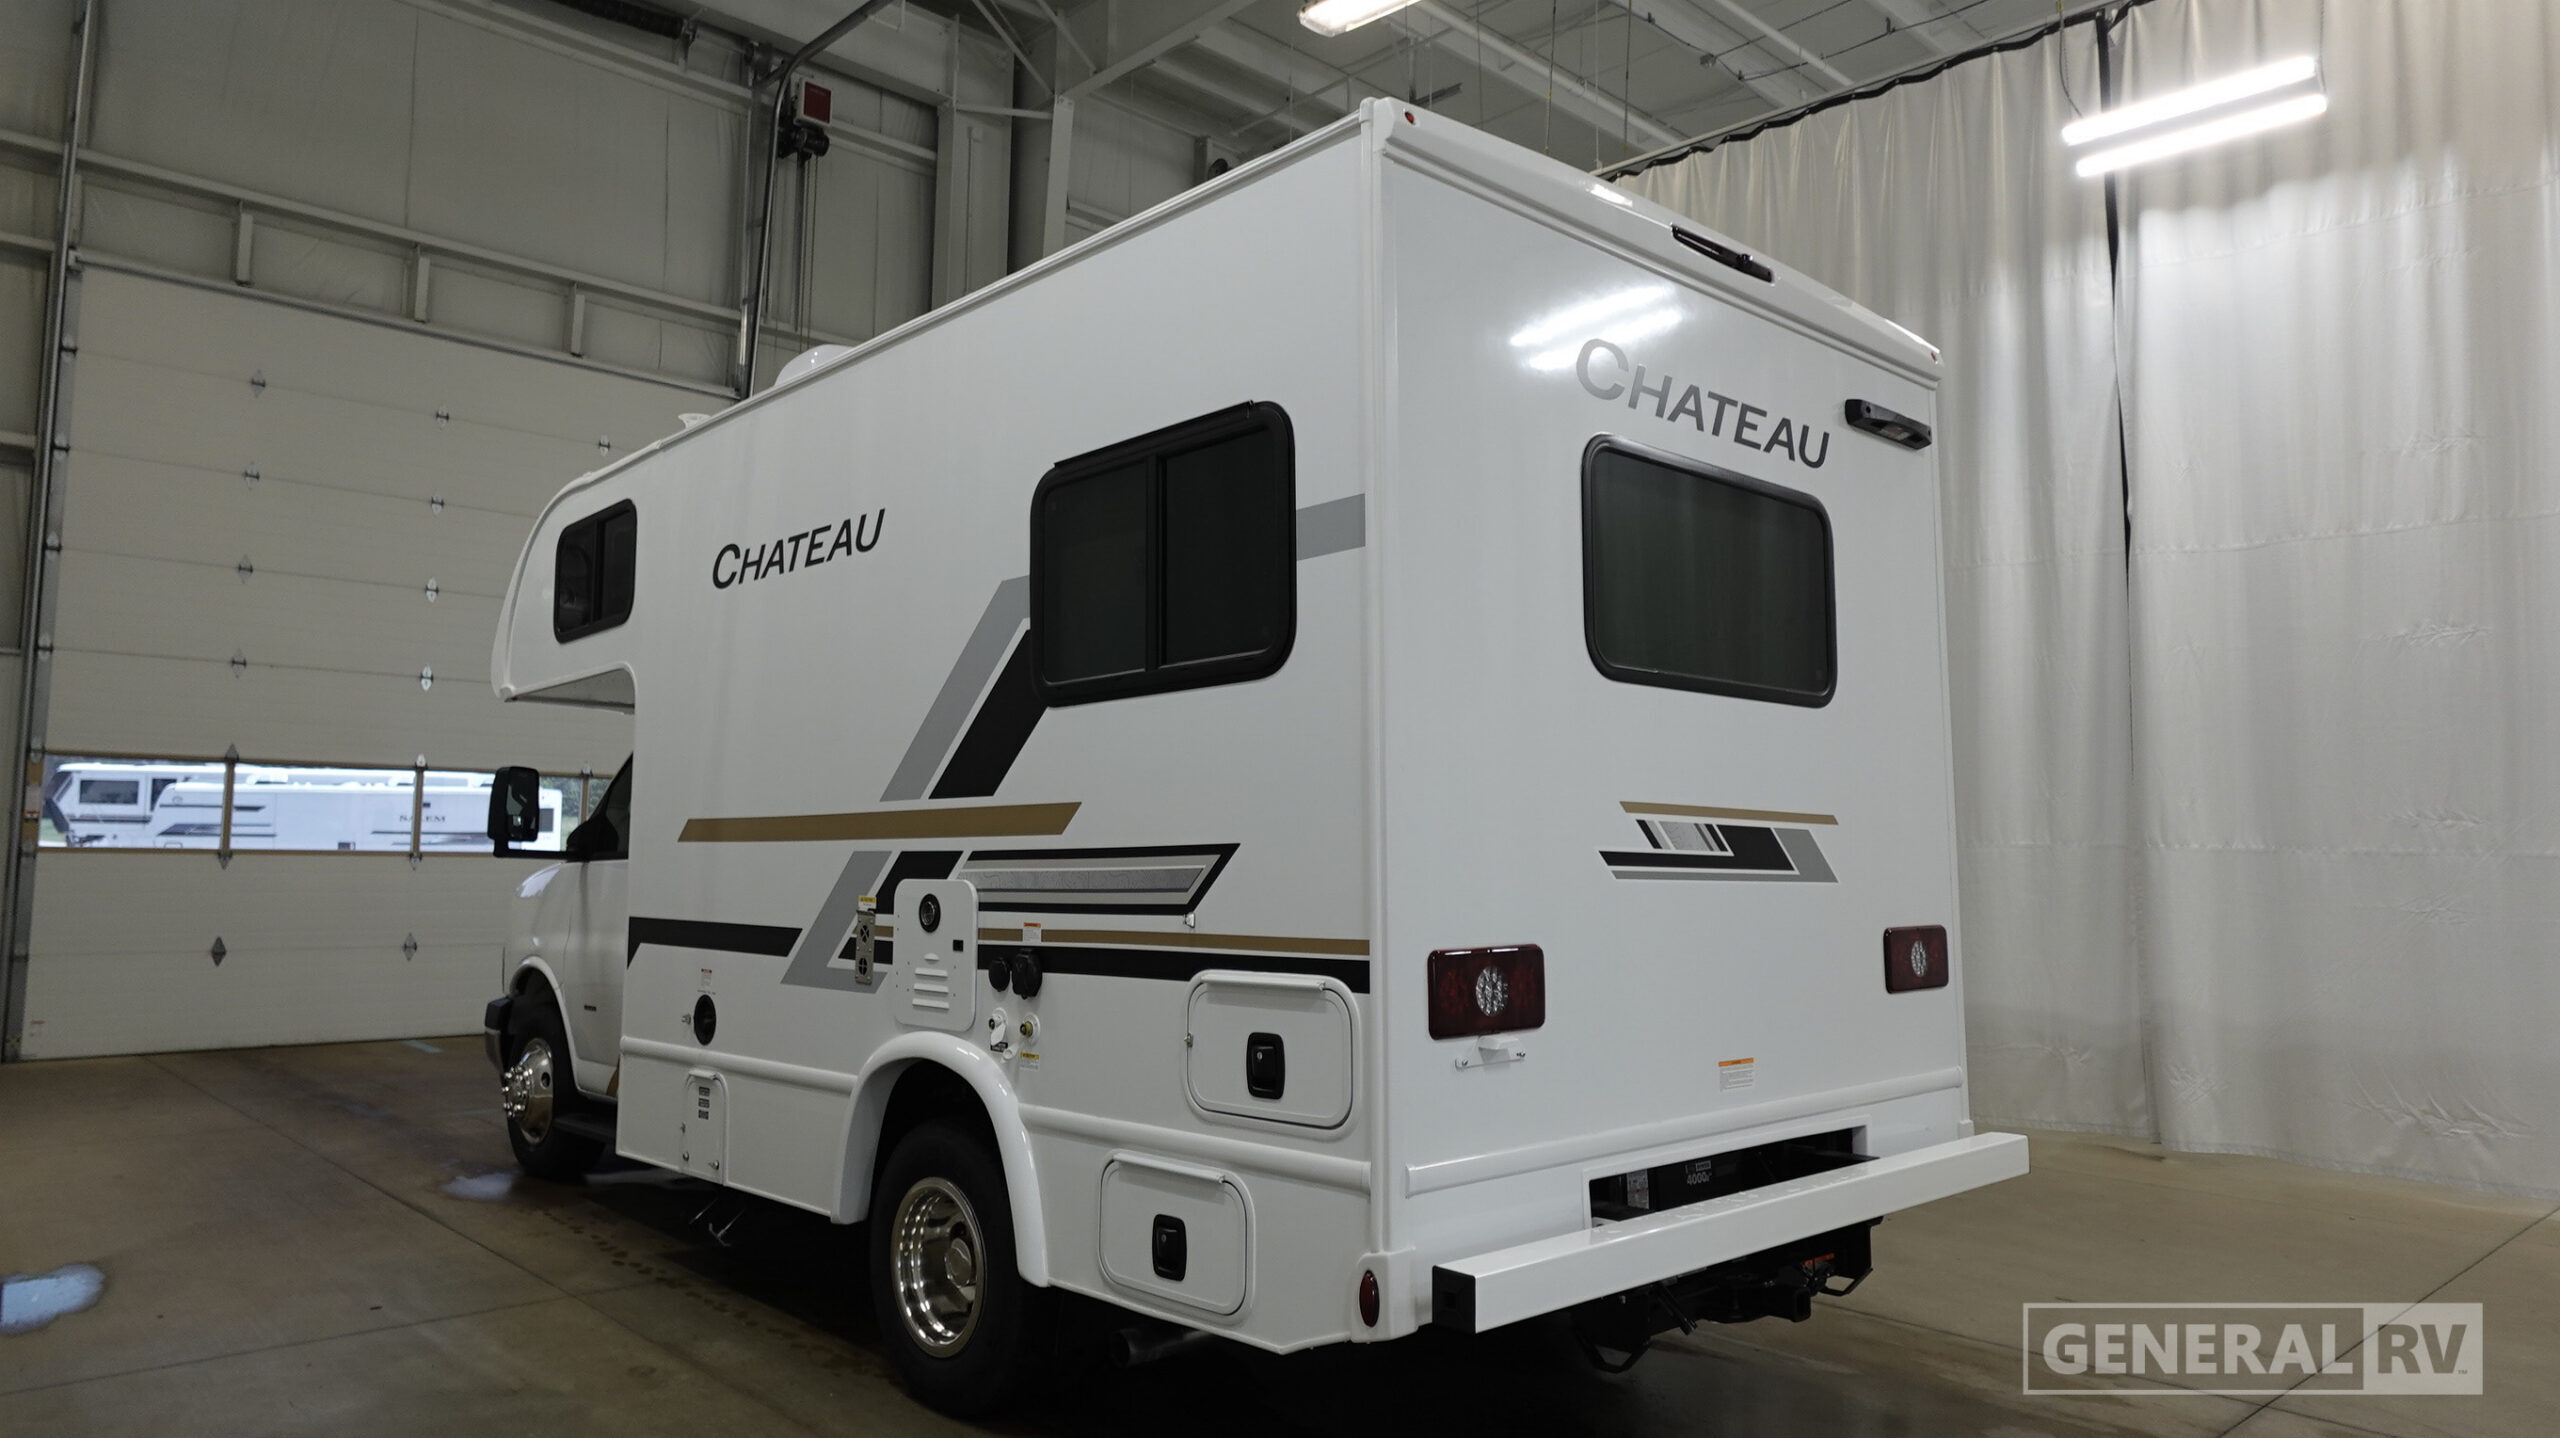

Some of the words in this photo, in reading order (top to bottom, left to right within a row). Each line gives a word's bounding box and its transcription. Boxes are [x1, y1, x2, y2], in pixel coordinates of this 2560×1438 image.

[1576, 338, 1830, 469] CHATEAU
[712, 507, 886, 590] CHATEAU
[399, 815, 446, 823] SAEM
